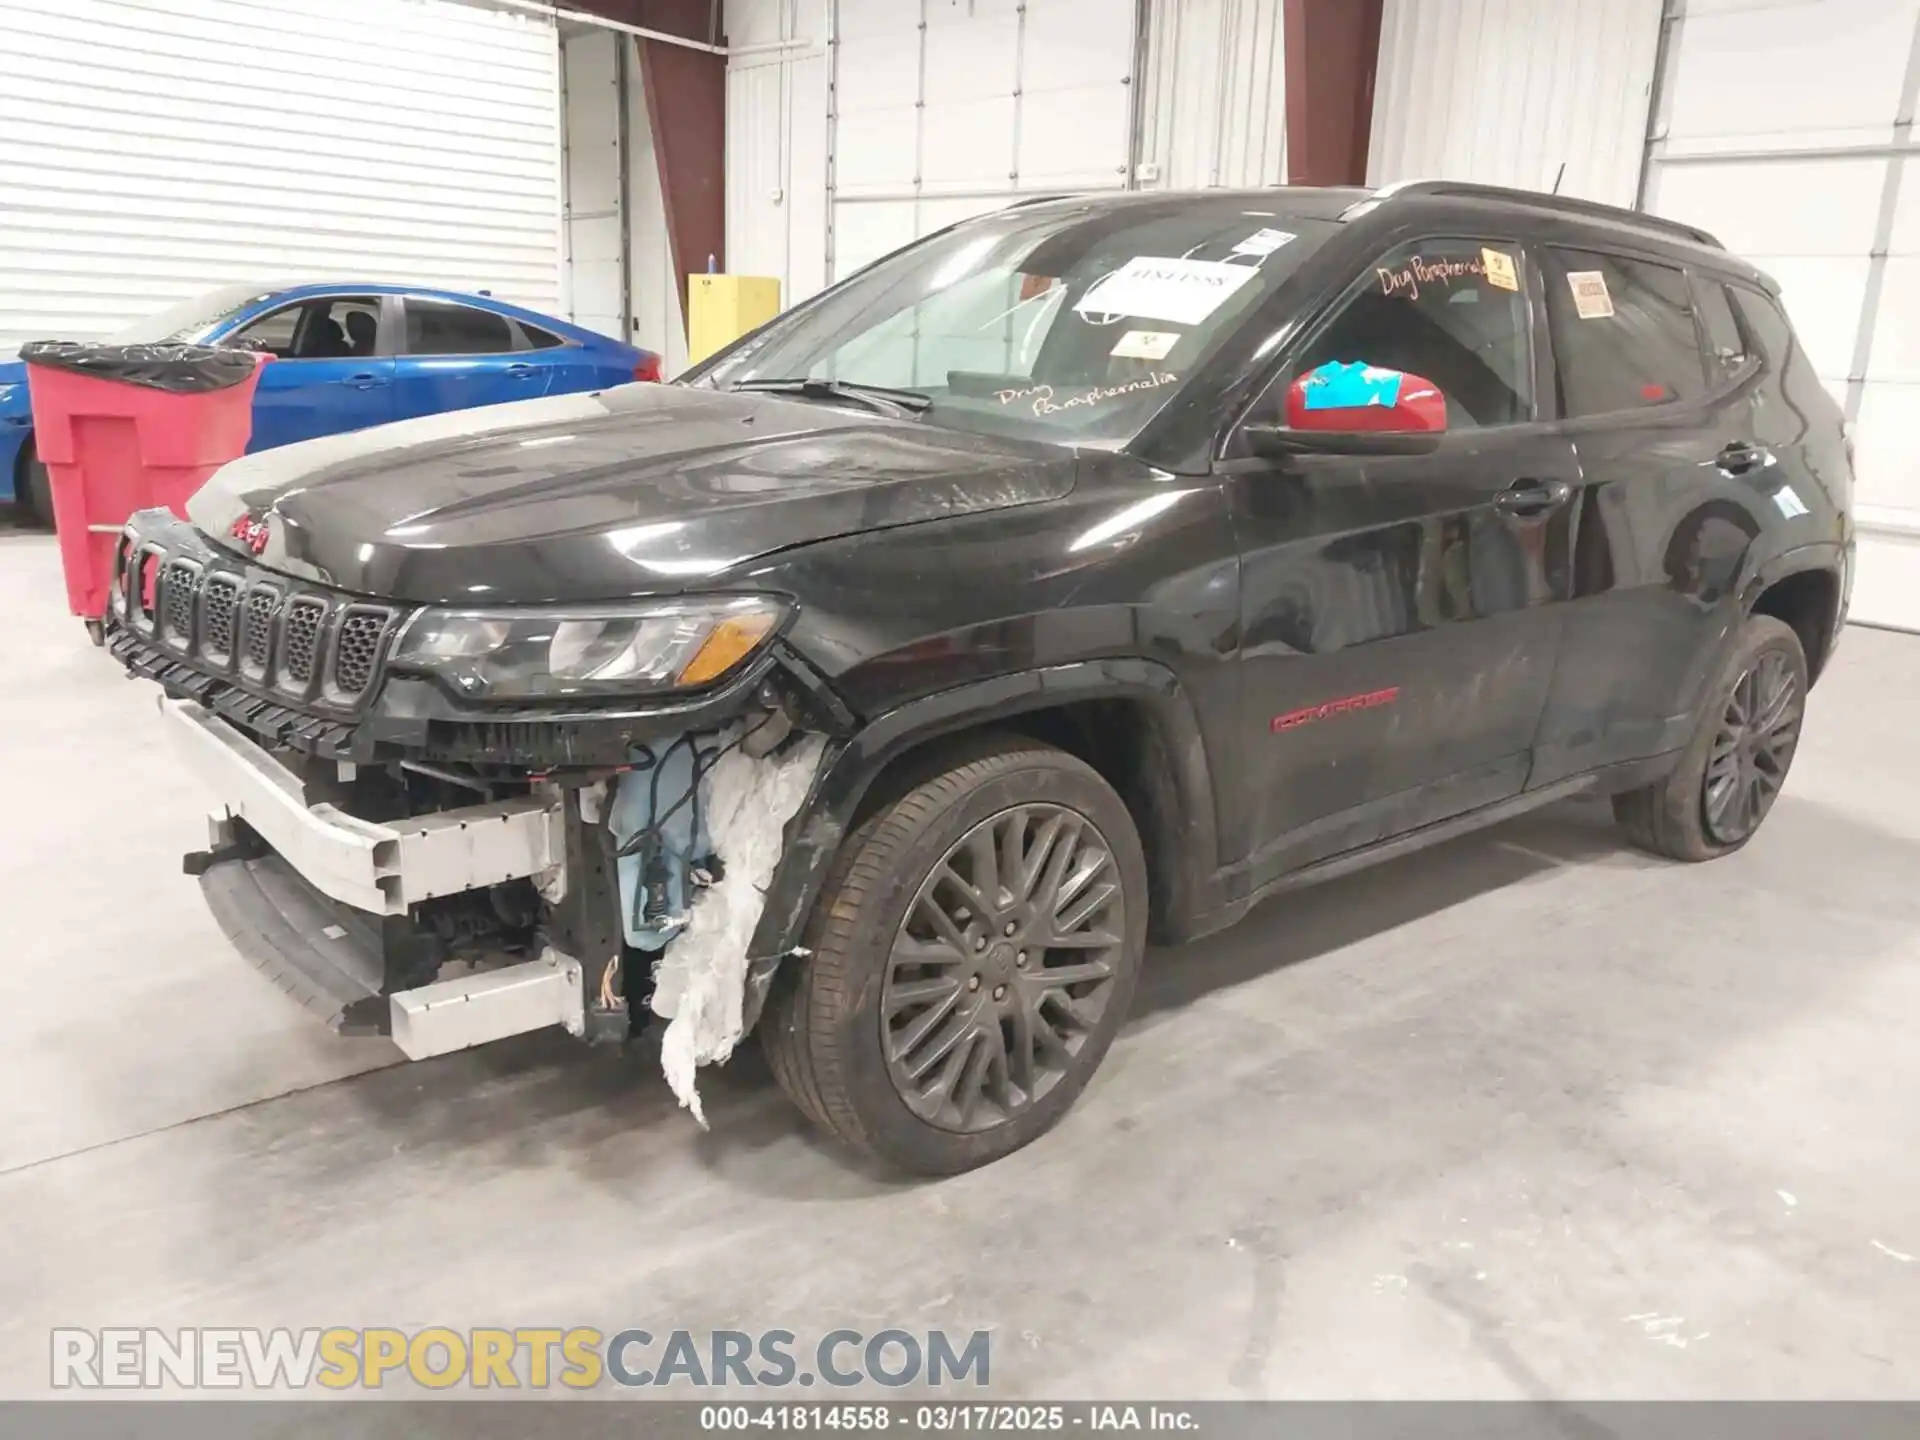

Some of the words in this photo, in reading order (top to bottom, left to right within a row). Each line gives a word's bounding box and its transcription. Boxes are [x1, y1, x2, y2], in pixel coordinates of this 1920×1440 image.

[1376, 267, 1418, 301] Drug
[992, 384, 1054, 405] Drug
[1032, 371, 1178, 417] Paraphernalia
